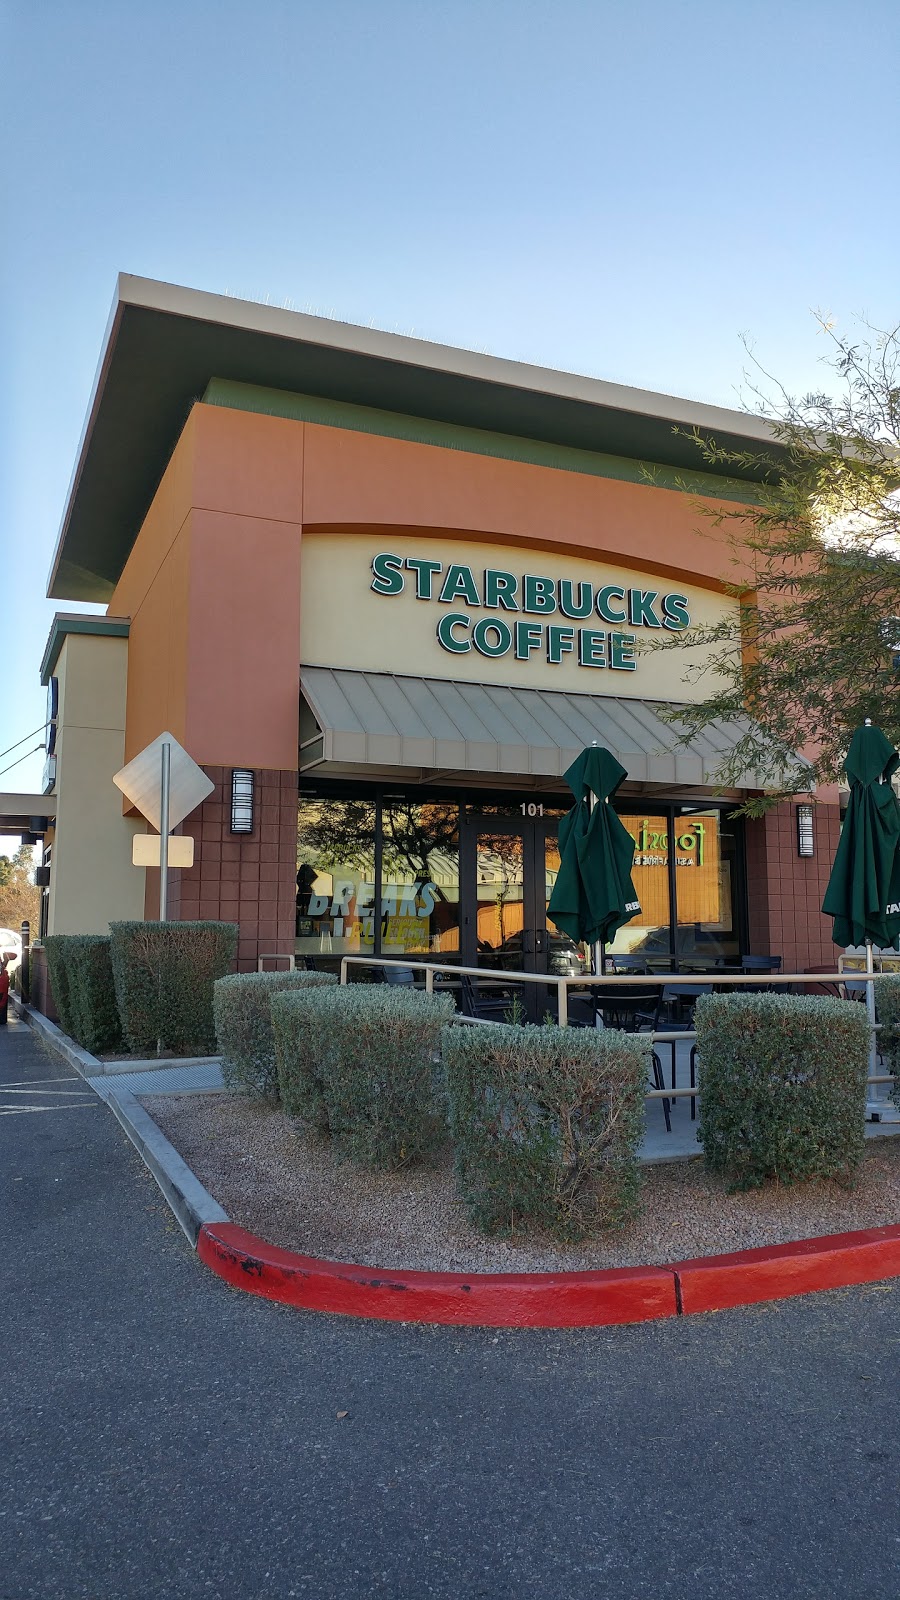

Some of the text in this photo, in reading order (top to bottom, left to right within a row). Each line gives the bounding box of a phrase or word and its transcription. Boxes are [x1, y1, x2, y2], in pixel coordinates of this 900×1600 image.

[370, 552, 691, 631] STARBUCKS
[437, 612, 637, 671] COFFEE
[519, 802, 543, 817] 101
